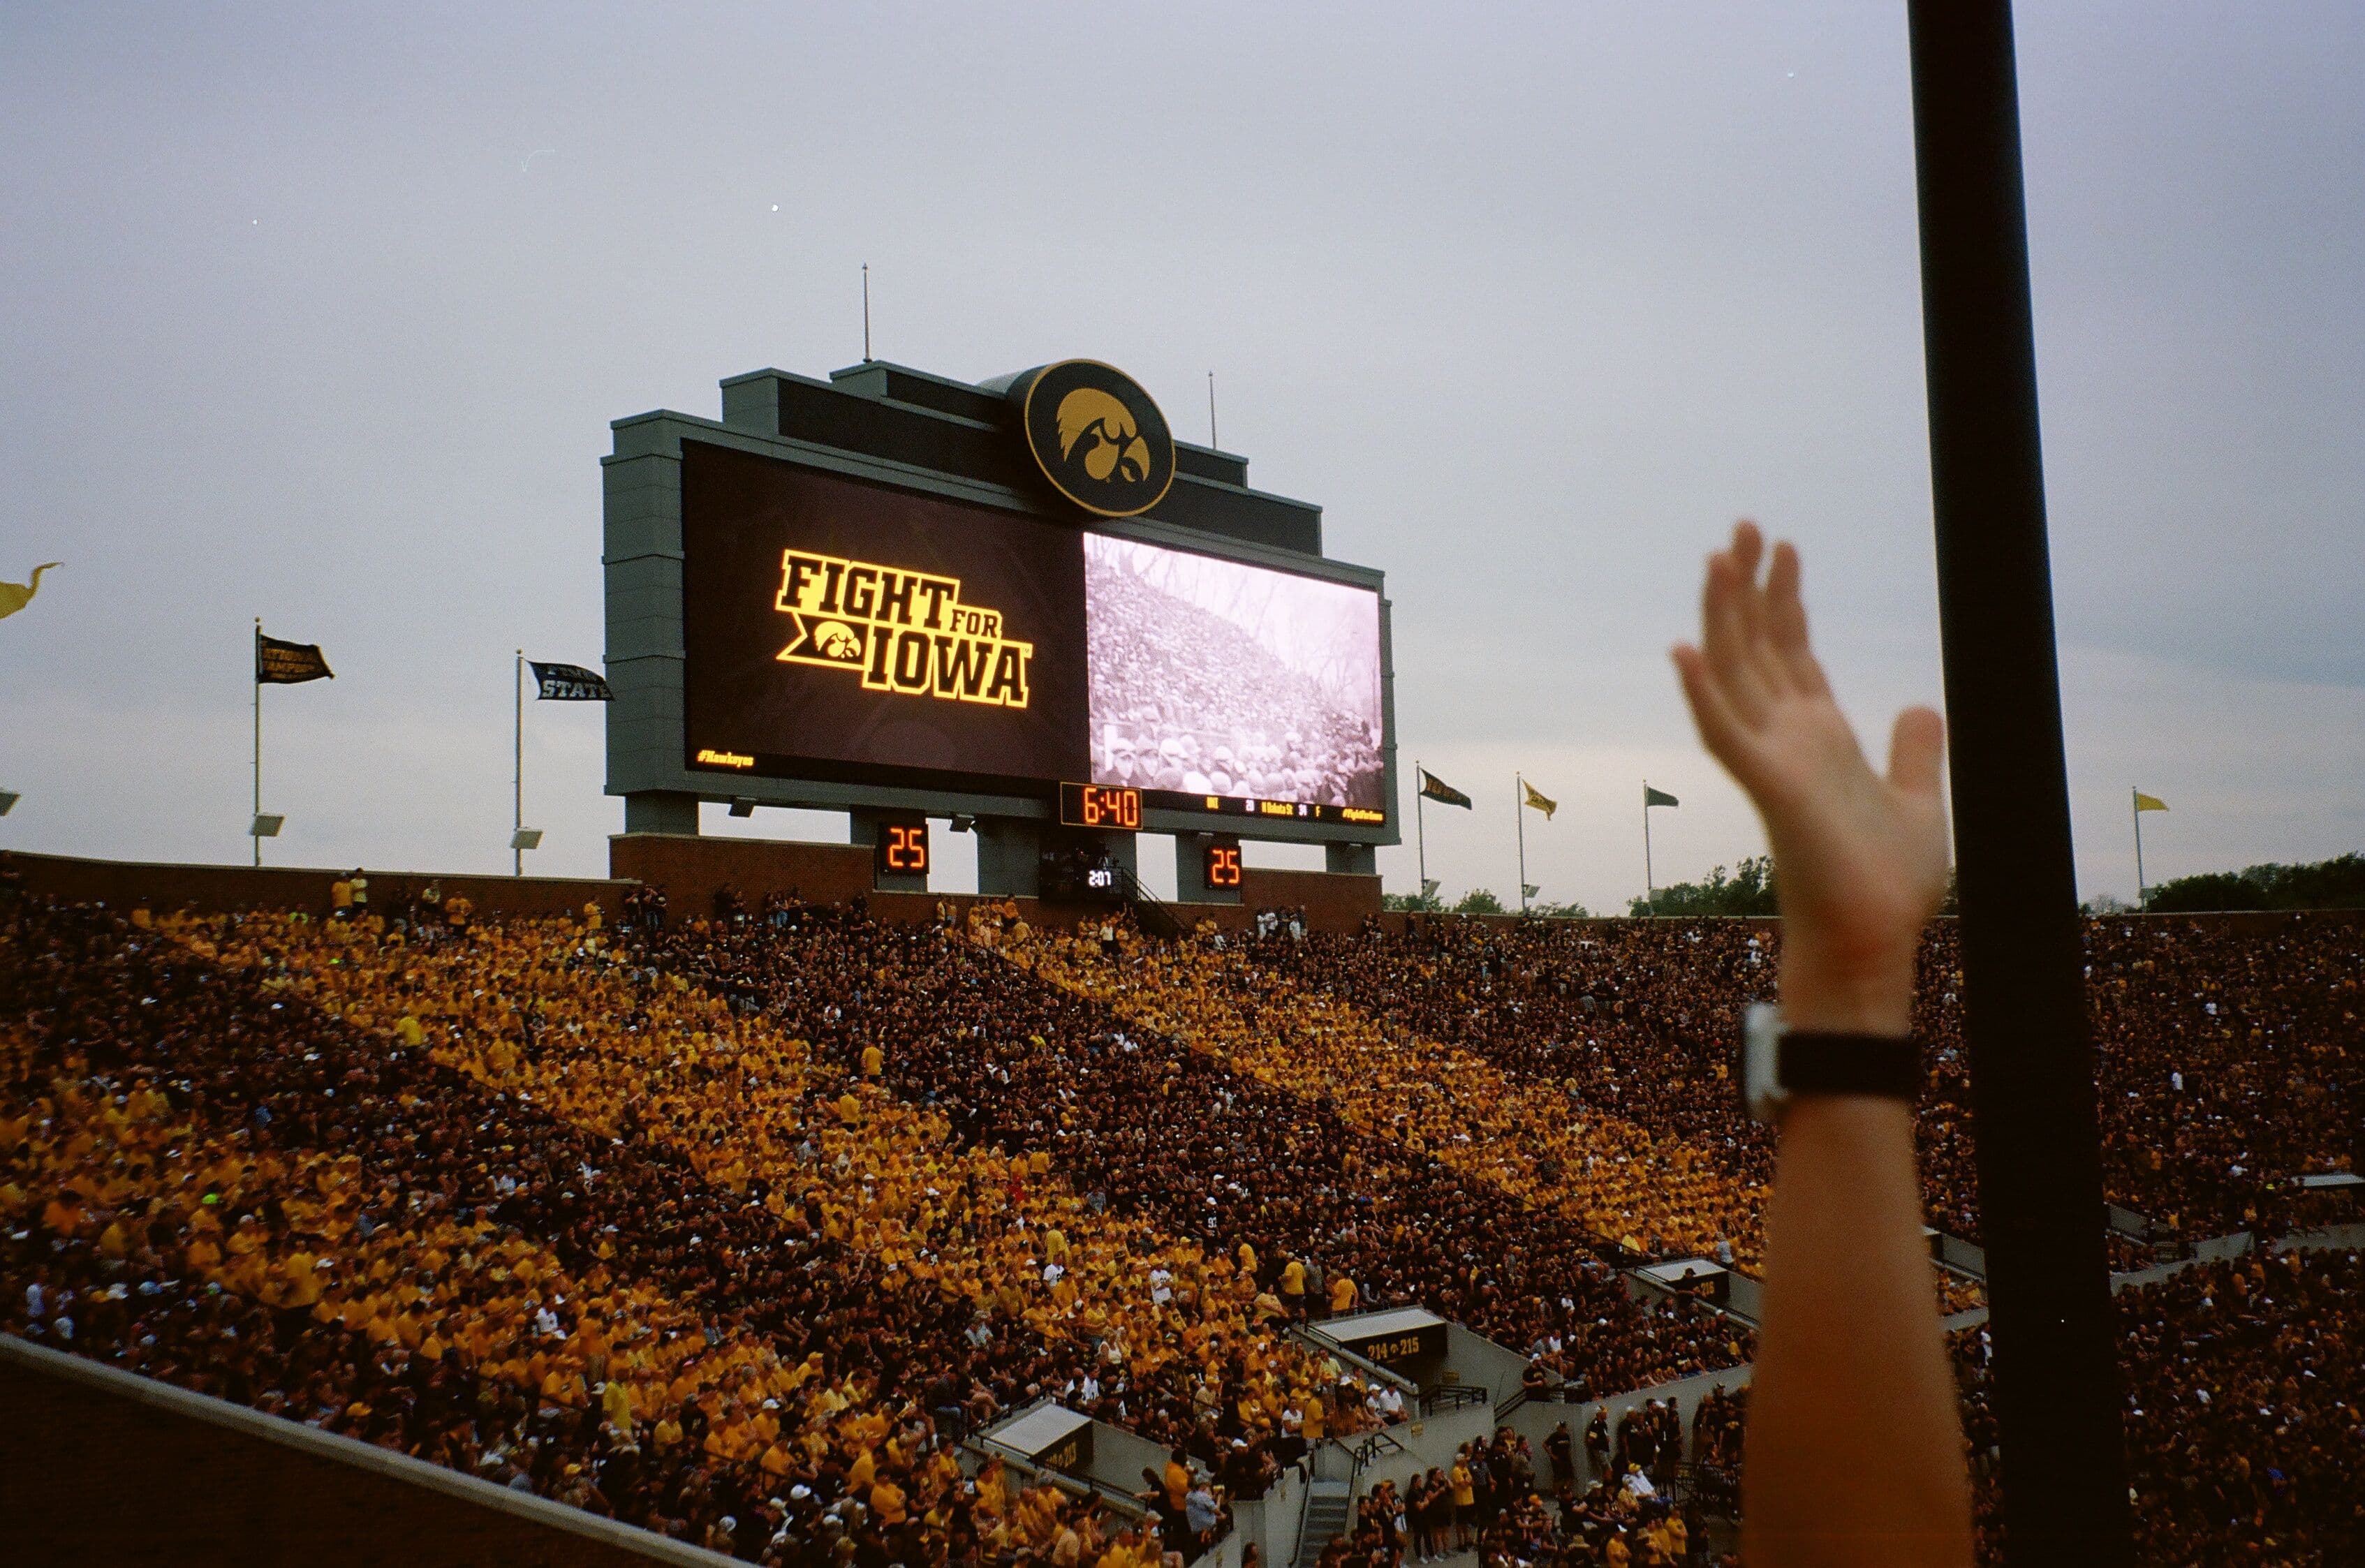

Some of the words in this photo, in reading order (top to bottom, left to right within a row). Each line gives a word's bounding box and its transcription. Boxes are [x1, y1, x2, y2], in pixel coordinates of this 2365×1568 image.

[780, 556, 955, 629] FIGHT
[950, 609, 999, 638] FOR
[867, 625, 1024, 702] IOWA
[542, 679, 612, 697] STATE
[698, 750, 754, 768] #Hawkeyes
[1084, 787, 1139, 827] 6:40
[1267, 801, 1286, 815] Dakota
[889, 828, 924, 868] 25
[1088, 869, 1112, 887] 2:07
[1212, 849, 1240, 886] 25
[1368, 1343, 1388, 1361] 214
[1400, 1336, 1419, 1356] 215
